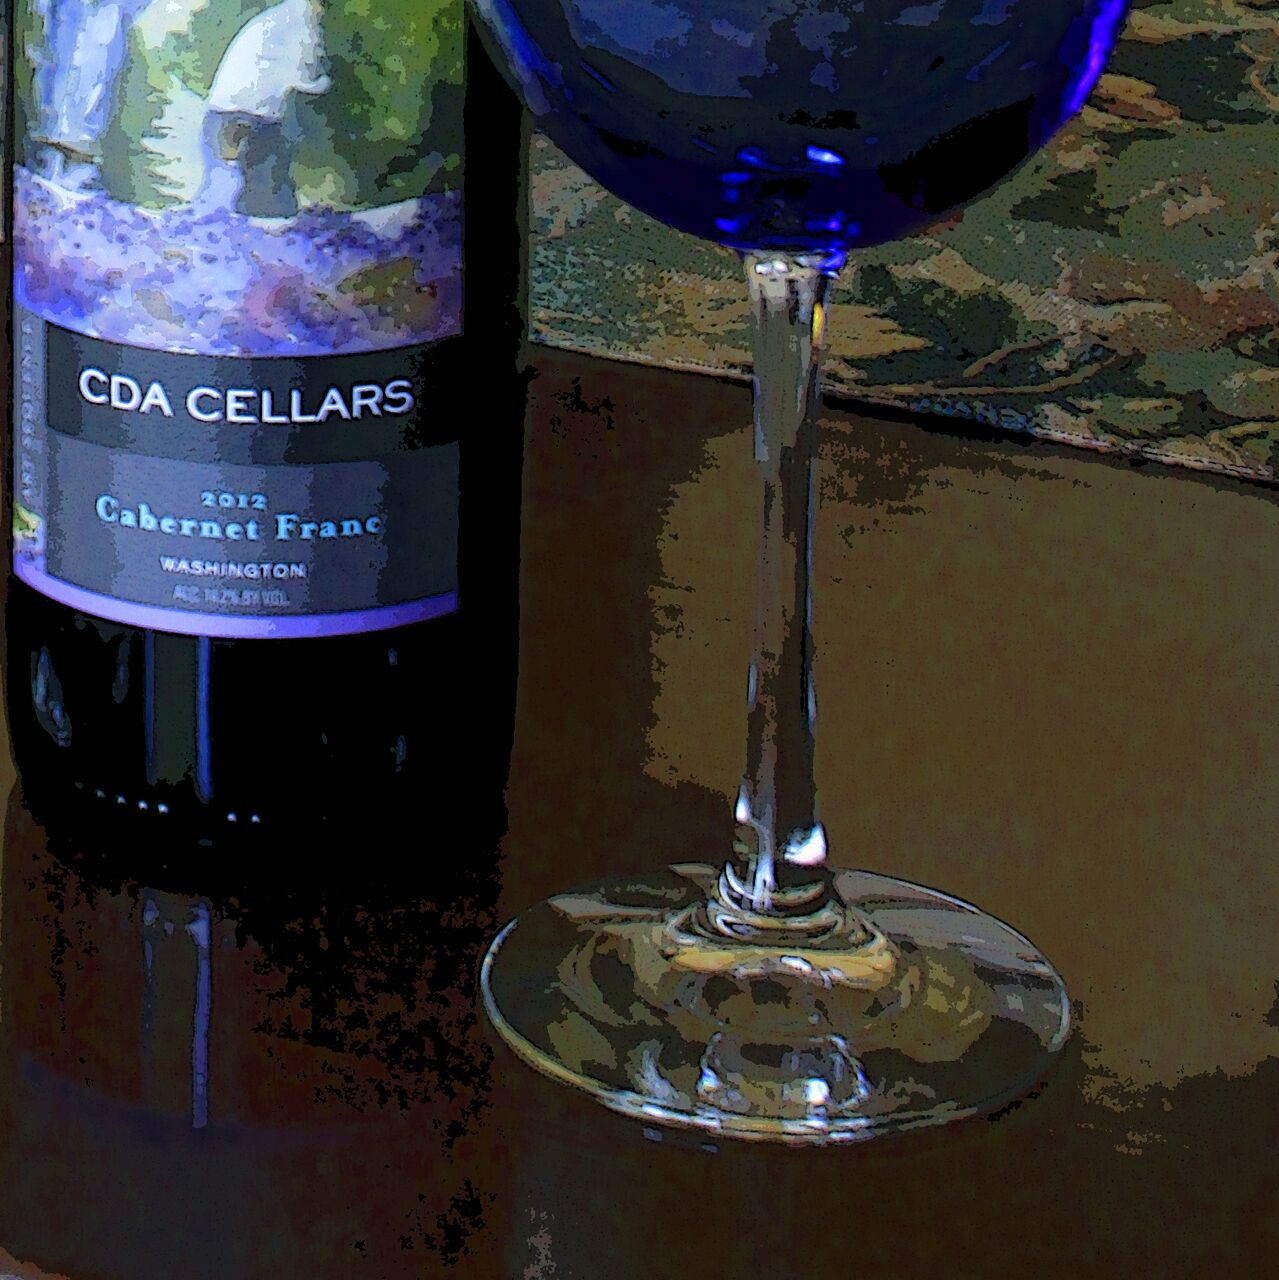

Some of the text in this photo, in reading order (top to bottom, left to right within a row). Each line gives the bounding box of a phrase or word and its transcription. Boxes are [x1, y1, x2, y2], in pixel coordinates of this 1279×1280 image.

[78, 368, 416, 425] CDA CELLARS
[94, 493, 383, 541] Cabernet Franc
[199, 490, 269, 512] 2012
[159, 555, 308, 580] WASHINGTON
